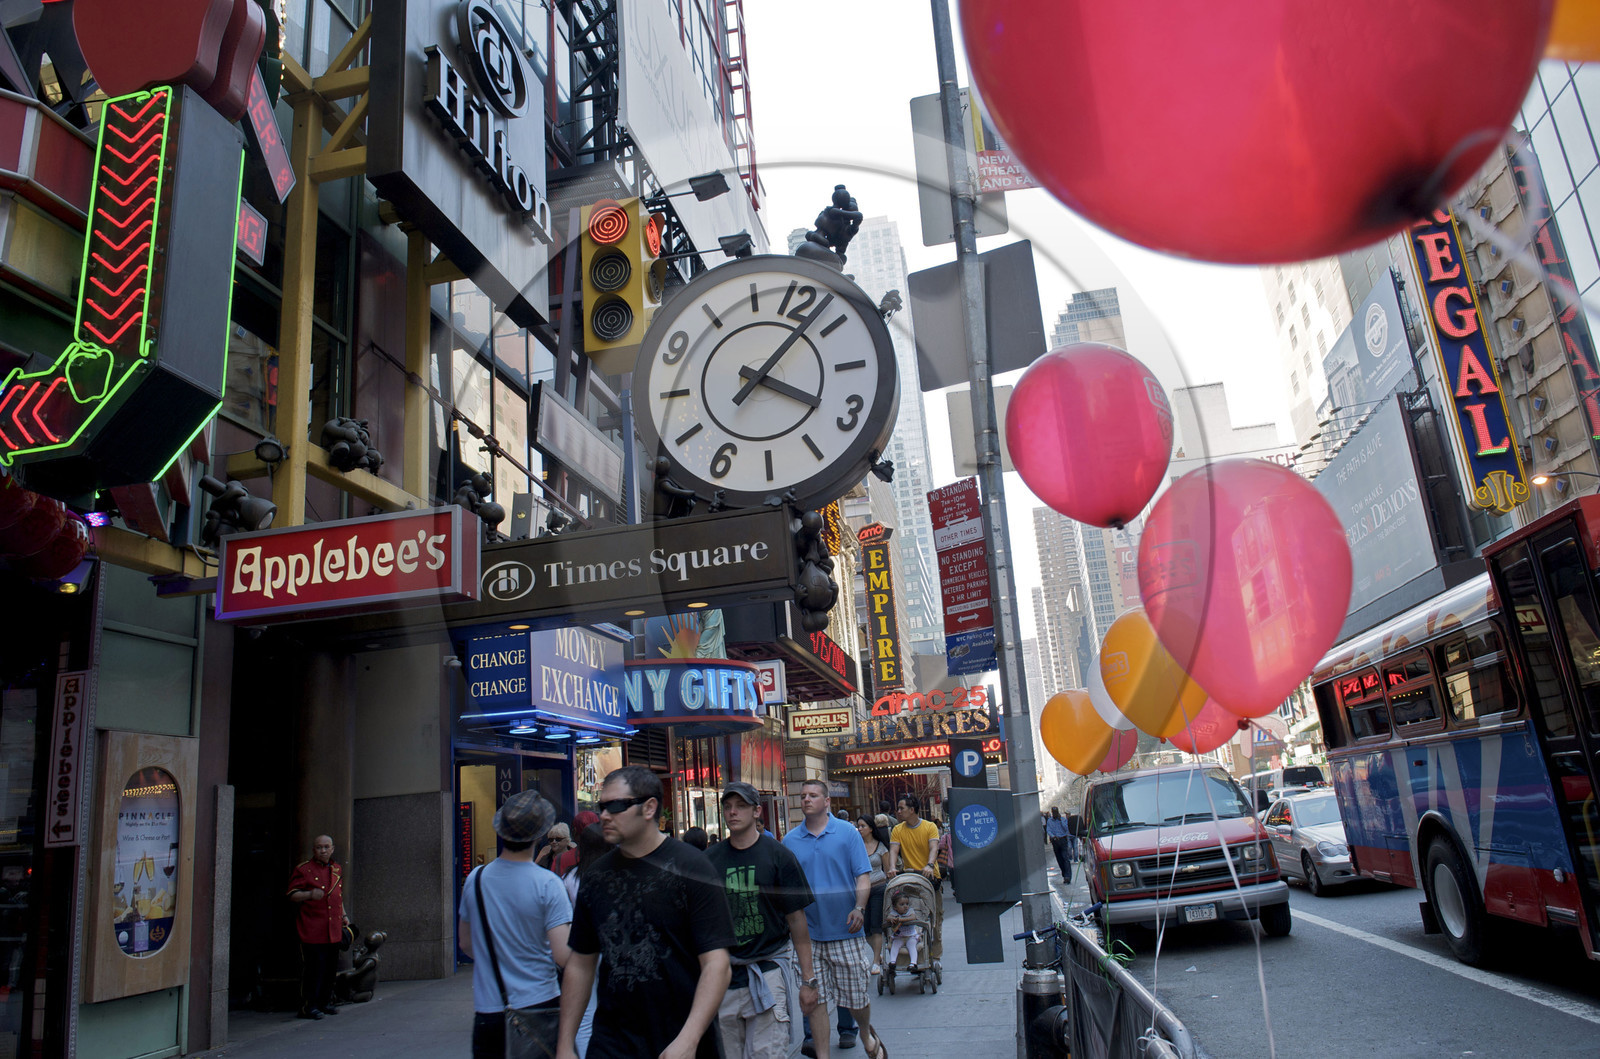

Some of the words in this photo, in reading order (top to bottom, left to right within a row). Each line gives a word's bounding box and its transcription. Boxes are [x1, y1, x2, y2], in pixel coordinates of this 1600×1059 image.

[430, 45, 553, 243] Hilton
[980, 155, 1010, 165] NEW
[982, 178, 1012, 188] AND
[777, 280, 818, 322] 12
[662, 330, 690, 365] 9
[836, 394, 864, 432] 3
[709, 442, 738, 479] 6
[1335, 469, 1347, 486] THE
[1345, 455, 1360, 477] PATH
[1359, 449, 1367, 464] IS
[1366, 432, 1383, 457] ALIVE
[930, 493, 939, 502] NO
[942, 480, 974, 498] STANDING
[939, 513, 954, 522] EXCEPT
[956, 507, 973, 516] SUNDAY
[1370, 478, 1417, 530] DEMONS
[941, 532, 958, 543] OTHER
[960, 527, 977, 536] TIMES
[232, 529, 446, 599] Applebee's
[544, 557, 642, 588] Times
[649, 540, 769, 582] Square
[941, 556, 950, 566] NO
[952, 546, 984, 563] STANDING
[949, 560, 977, 575] EXCEPT
[942, 574, 966, 587] COMMERCIAL
[968, 569, 988, 580] VEHICLES
[944, 584, 965, 595] METERED
[967, 579, 988, 590] PARKING
[967, 590, 982, 599] LIMIT
[868, 549, 897, 683] EMPIRE
[470, 649, 527, 670] CHANGE
[555, 628, 607, 672] MONEY
[470, 677, 527, 698] CHANGE
[541, 665, 621, 718] EXCHANGE
[624, 669, 671, 712] NY
[680, 668, 759, 711] GIFTS
[871, 689, 947, 716] amc
[951, 685, 987, 708] 25
[794, 713, 848, 728] MODELL'S
[53, 678, 80, 817] Applebee's
[963, 751, 979, 776] P
[119, 812, 172, 820] PINNACLE
[961, 812, 971, 826] P
[973, 811, 989, 819] MUNI
[974, 817, 994, 825] METER
[725, 865, 760, 895] ALL
